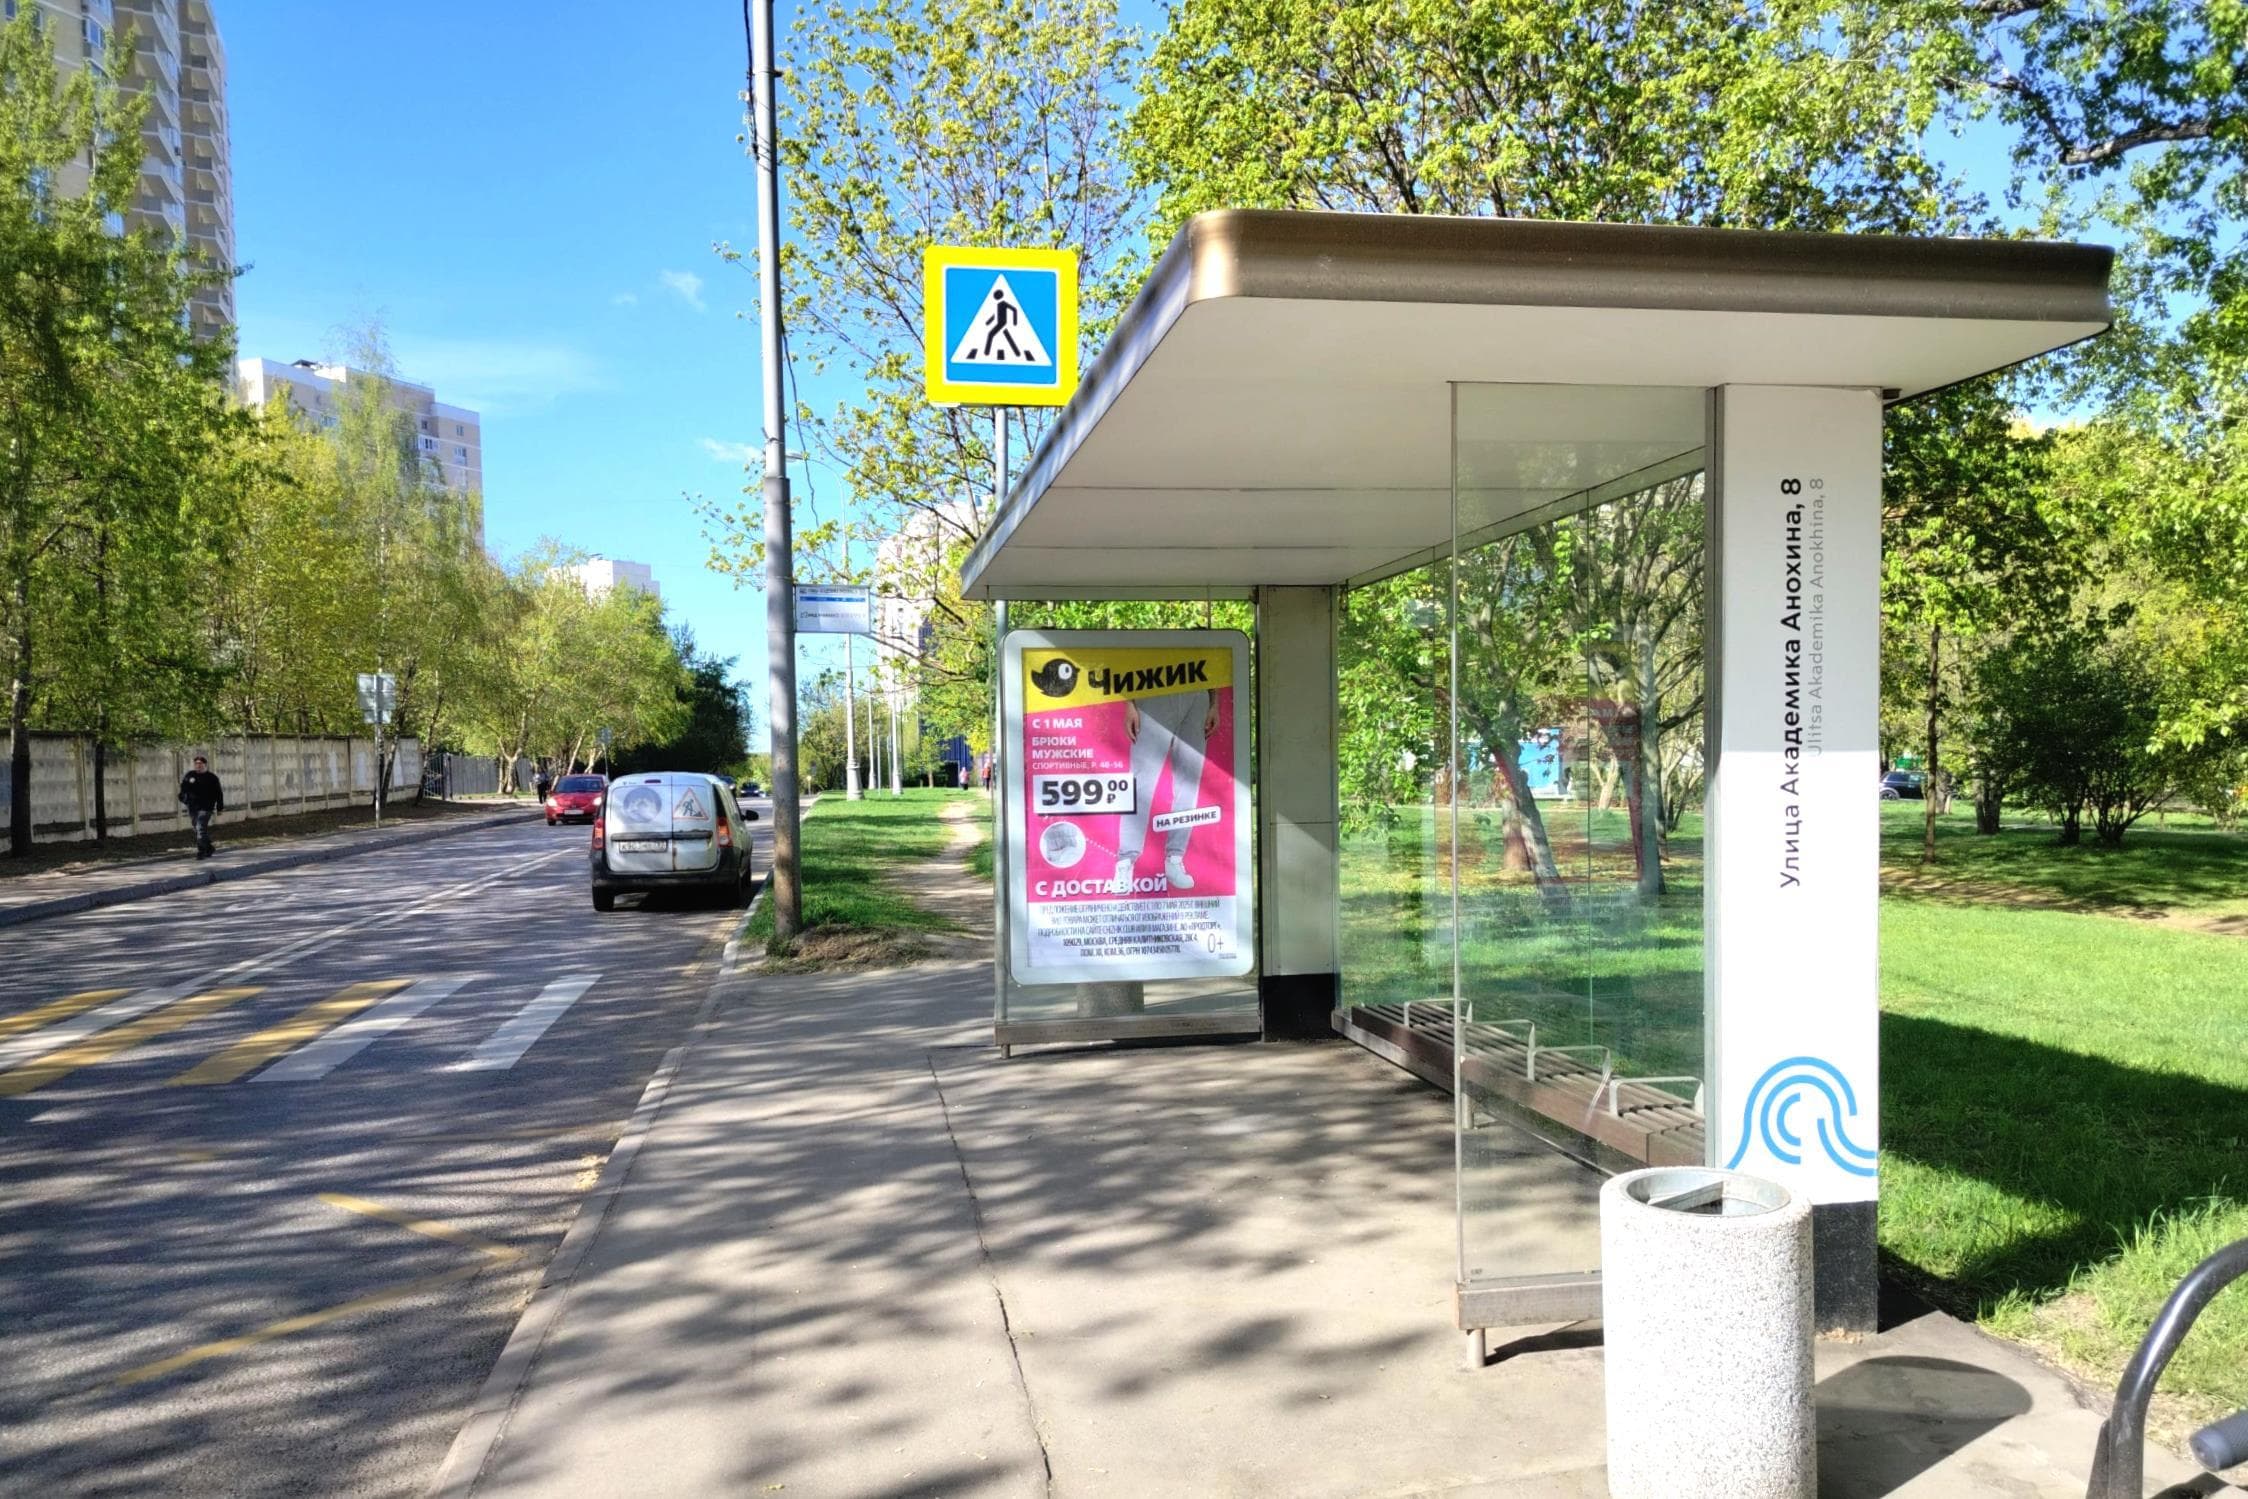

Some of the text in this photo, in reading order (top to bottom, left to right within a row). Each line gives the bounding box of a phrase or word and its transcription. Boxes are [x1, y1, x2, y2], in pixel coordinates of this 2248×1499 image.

[1808, 478, 1827, 756] Ulitsa Akademika Anokhina, 8
[1779, 477, 1805, 888] Улица Академика Анохина, 8
[1032, 718, 1083, 729] С 1 МАЯ
[1032, 736, 1077, 747] БРЮКИ
[1032, 748, 1094, 760] МУЖСКИЕ
[1041, 779, 1104, 807] 599
[1156, 810, 1217, 829] НА РЕЗИНКЕ
[1035, 873, 1168, 898] С ДОСТАВКОЙ
[1207, 932, 1224, 954] 0+
